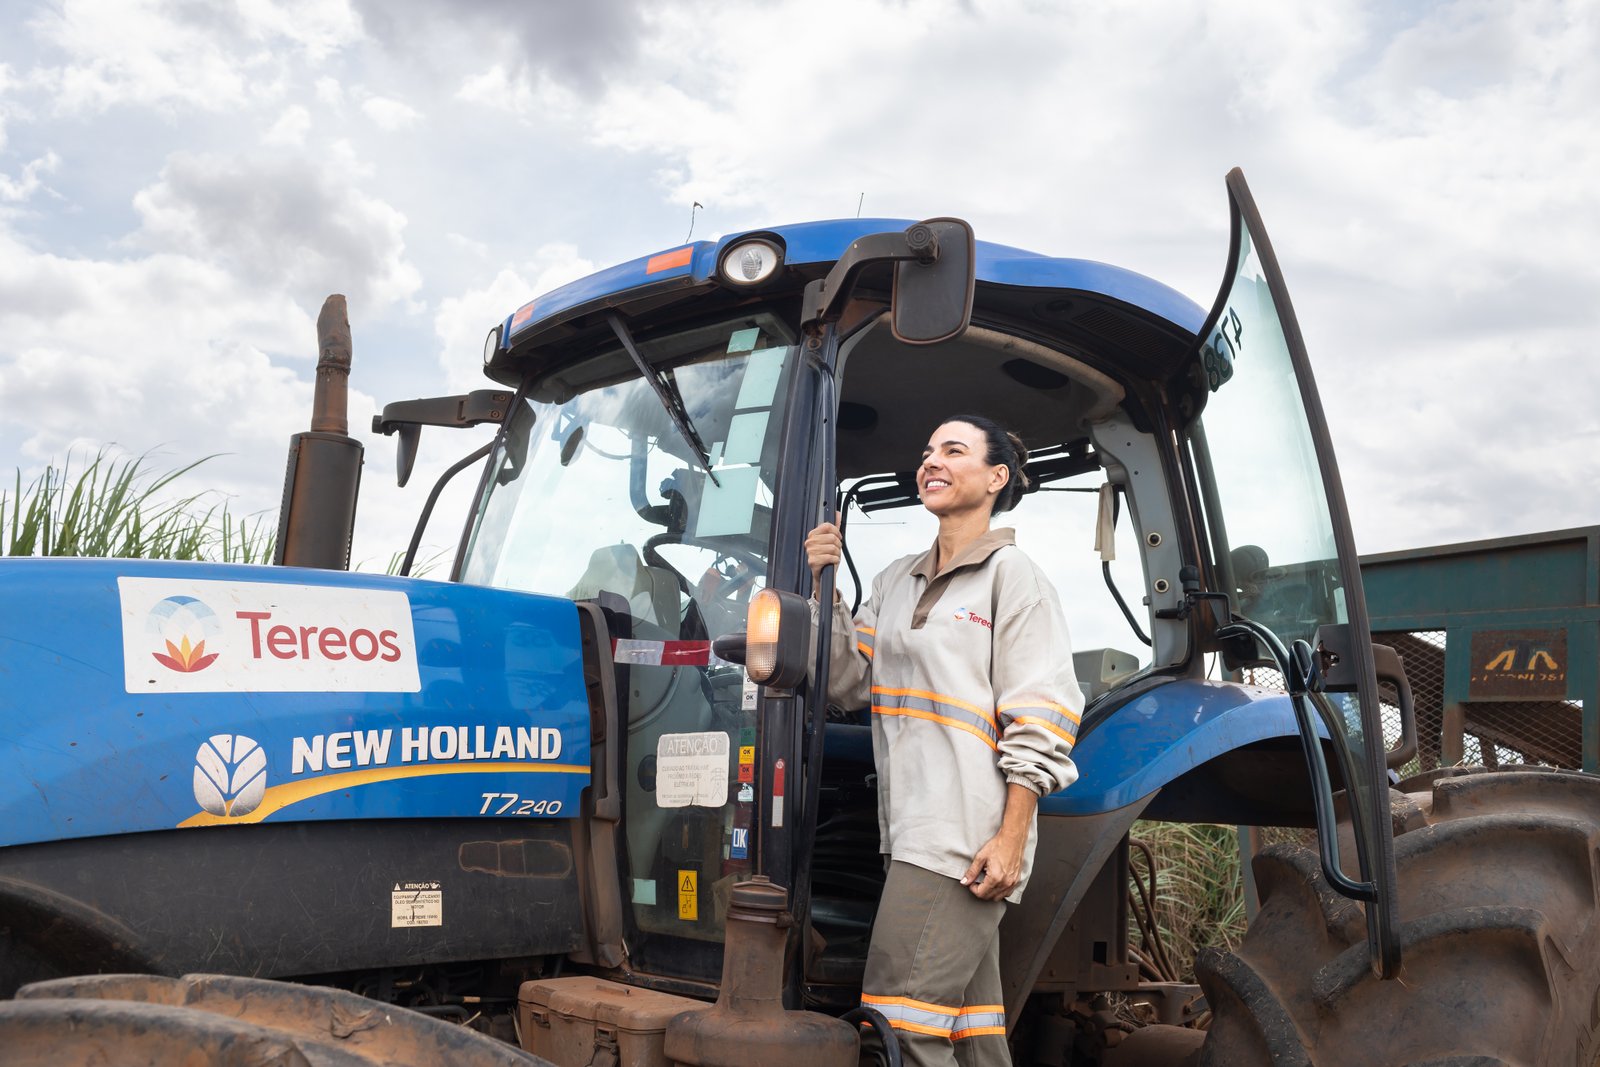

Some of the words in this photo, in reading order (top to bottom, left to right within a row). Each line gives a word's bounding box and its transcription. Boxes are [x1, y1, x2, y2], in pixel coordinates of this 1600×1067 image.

[969, 612, 993, 630] Tereo
[236, 611, 401, 663] Tereos
[291, 729, 392, 774] NEW
[401, 725, 562, 763] HOLLAND
[667, 736, 718, 756] ATENÇÃO
[479, 792, 562, 816] T7.240
[733, 828, 748, 848] OK
[405, 882, 429, 890] ATENÇÃO
